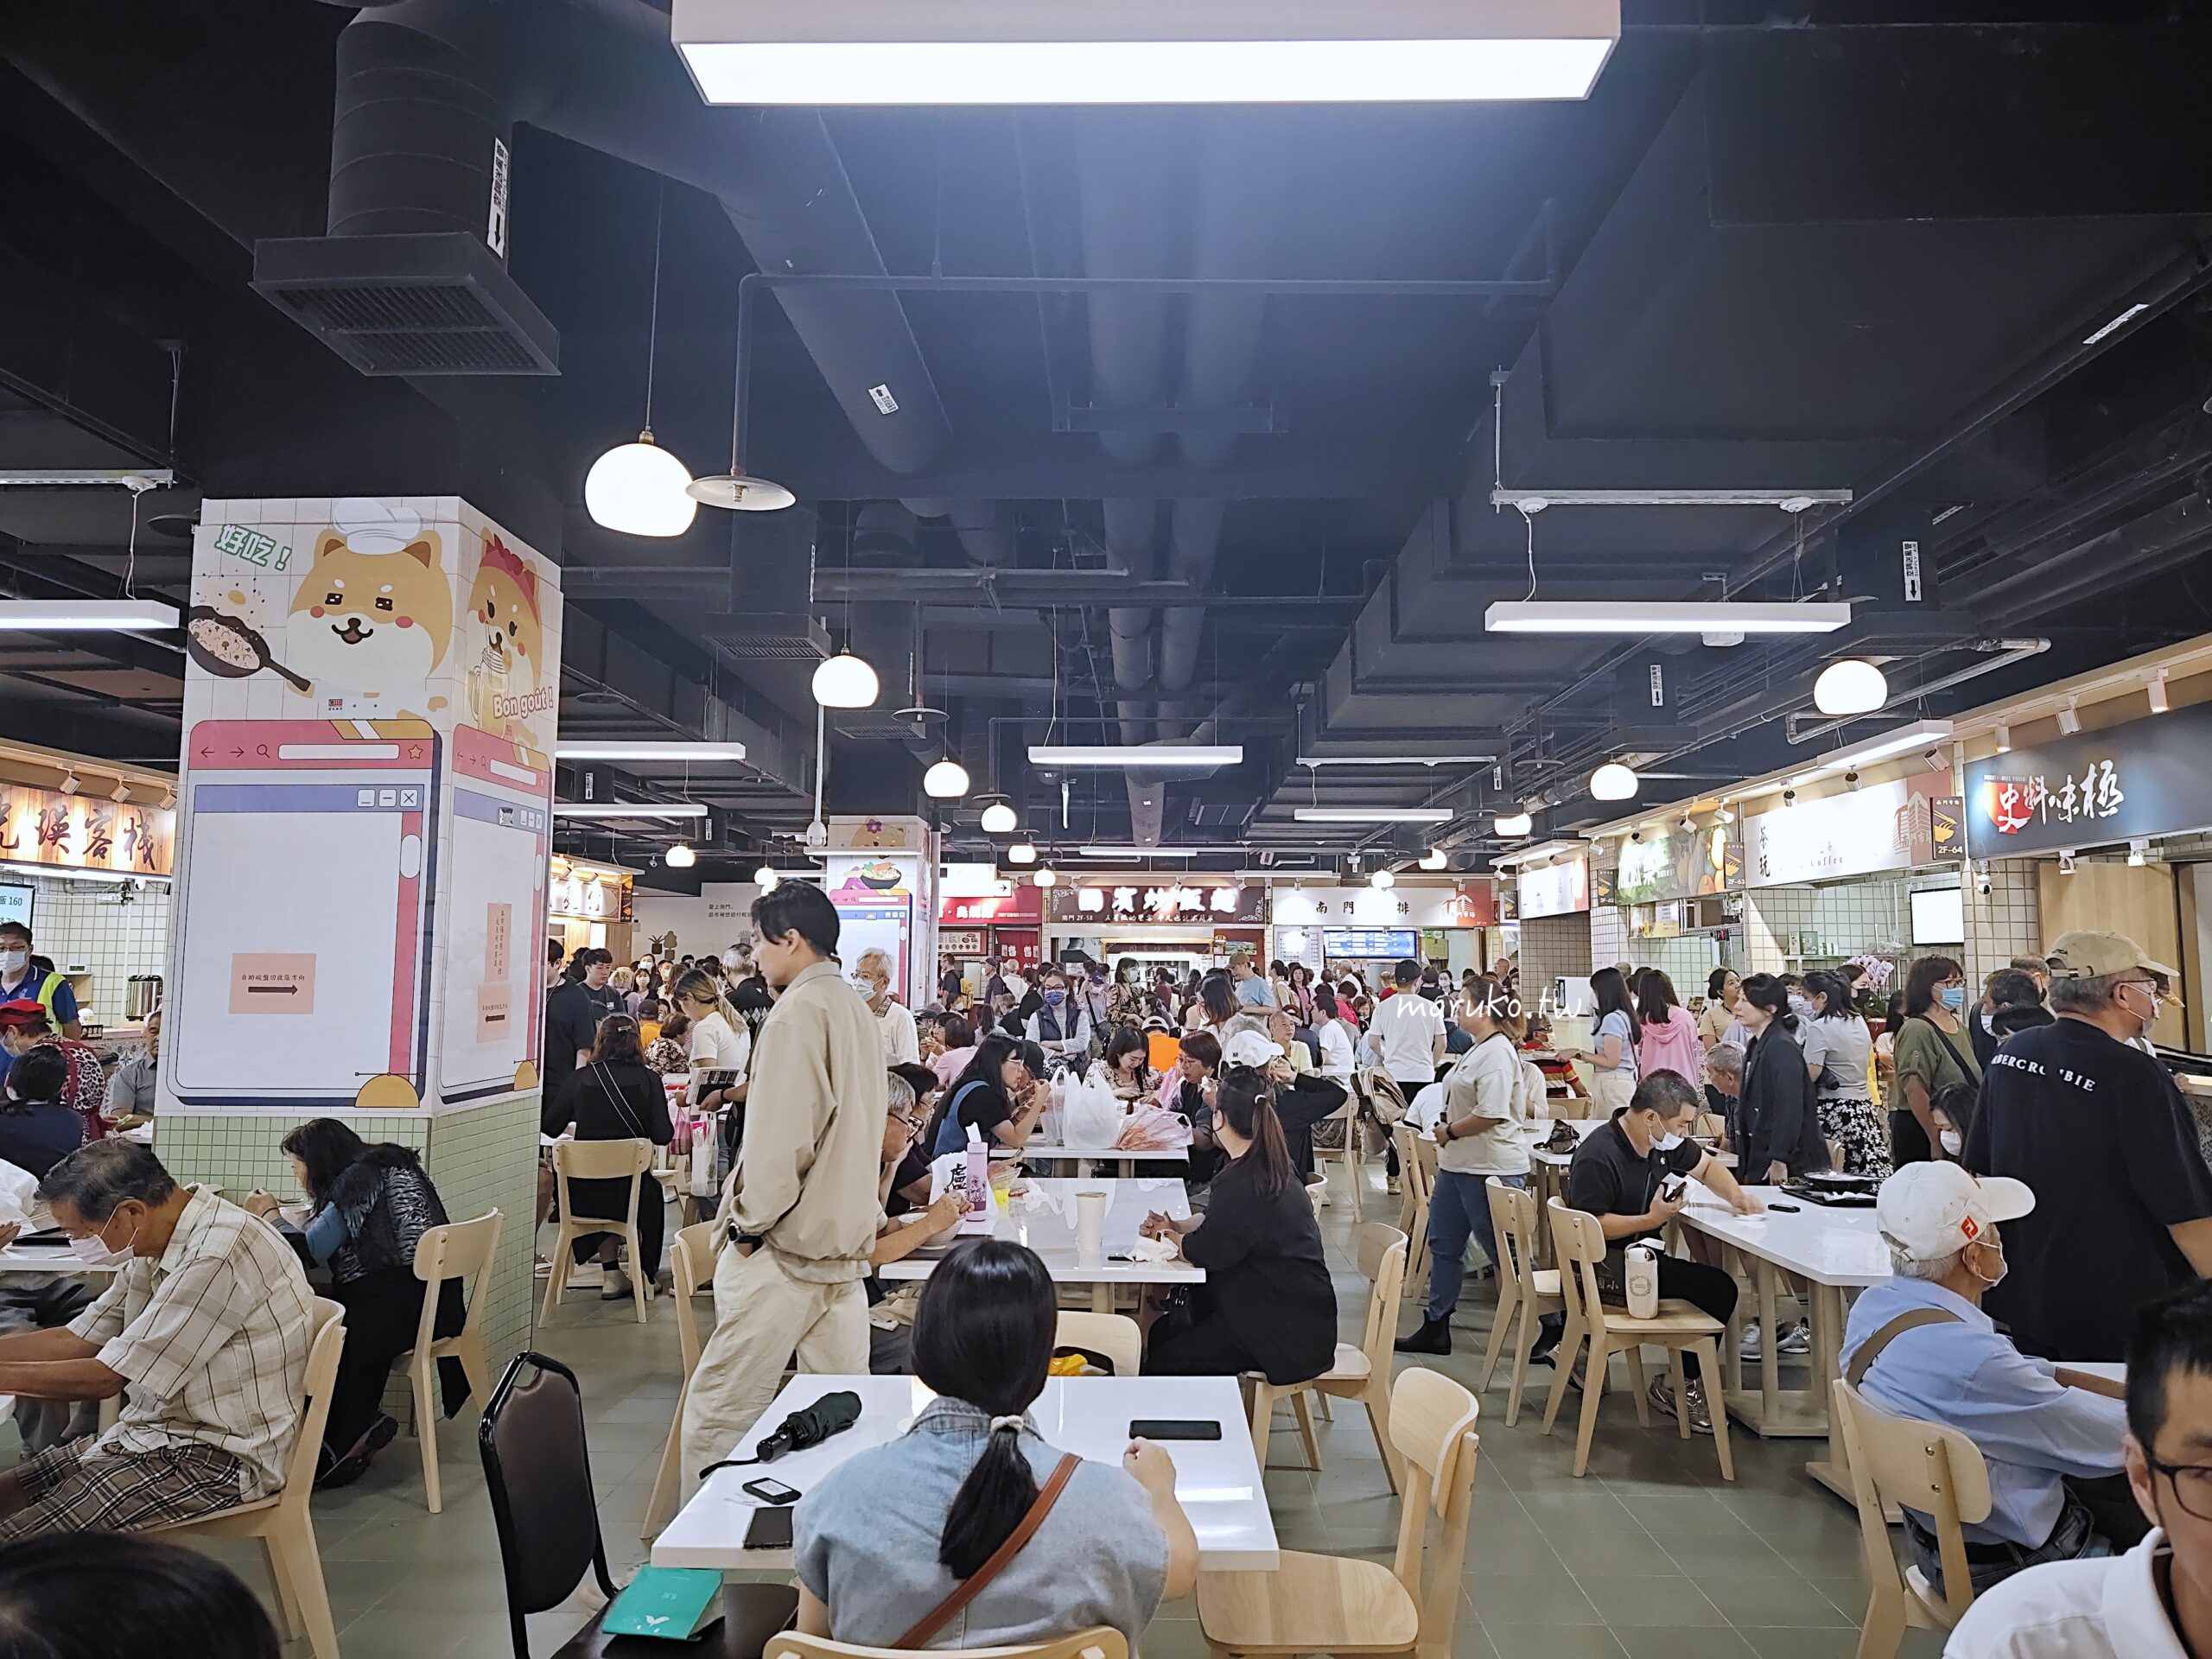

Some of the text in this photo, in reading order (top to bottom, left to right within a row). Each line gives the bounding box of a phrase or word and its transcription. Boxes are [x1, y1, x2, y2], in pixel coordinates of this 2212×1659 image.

[493, 694, 518, 719] Bon
[519, 690, 548, 720] goût
[1938, 845, 1963, 854] 2F-64
[9, 896, 22, 906] 160
